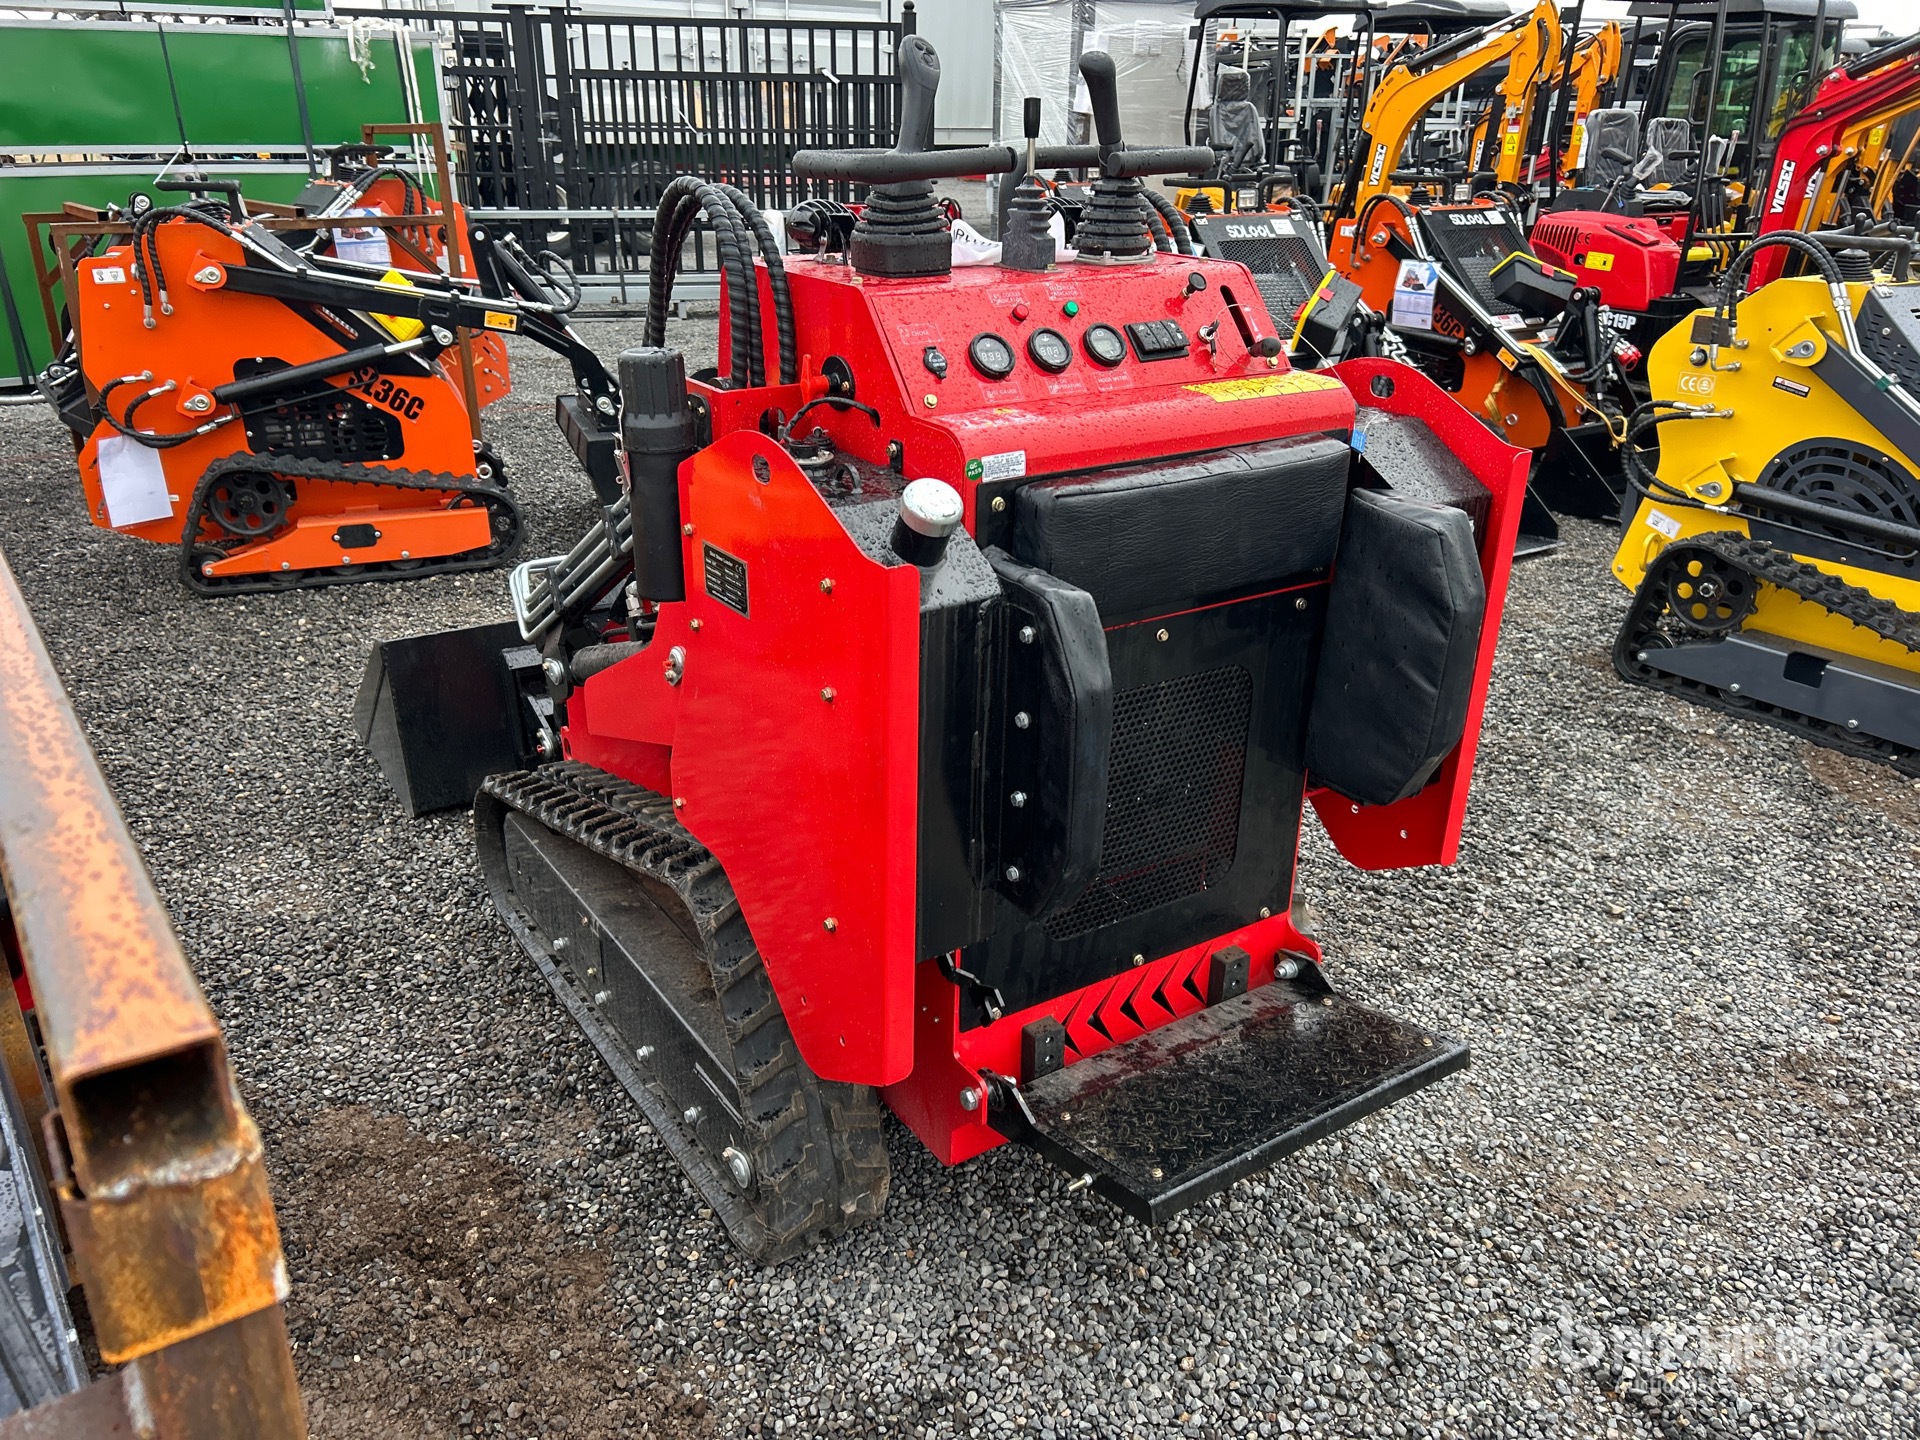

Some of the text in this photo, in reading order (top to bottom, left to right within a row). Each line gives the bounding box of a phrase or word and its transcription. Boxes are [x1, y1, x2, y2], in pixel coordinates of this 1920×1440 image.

[1368, 143, 1388, 186] VICSEC
[1770, 159, 1796, 213] VICSEC
[348, 366, 425, 420] SL36C
[967, 467, 982, 477] PASS
